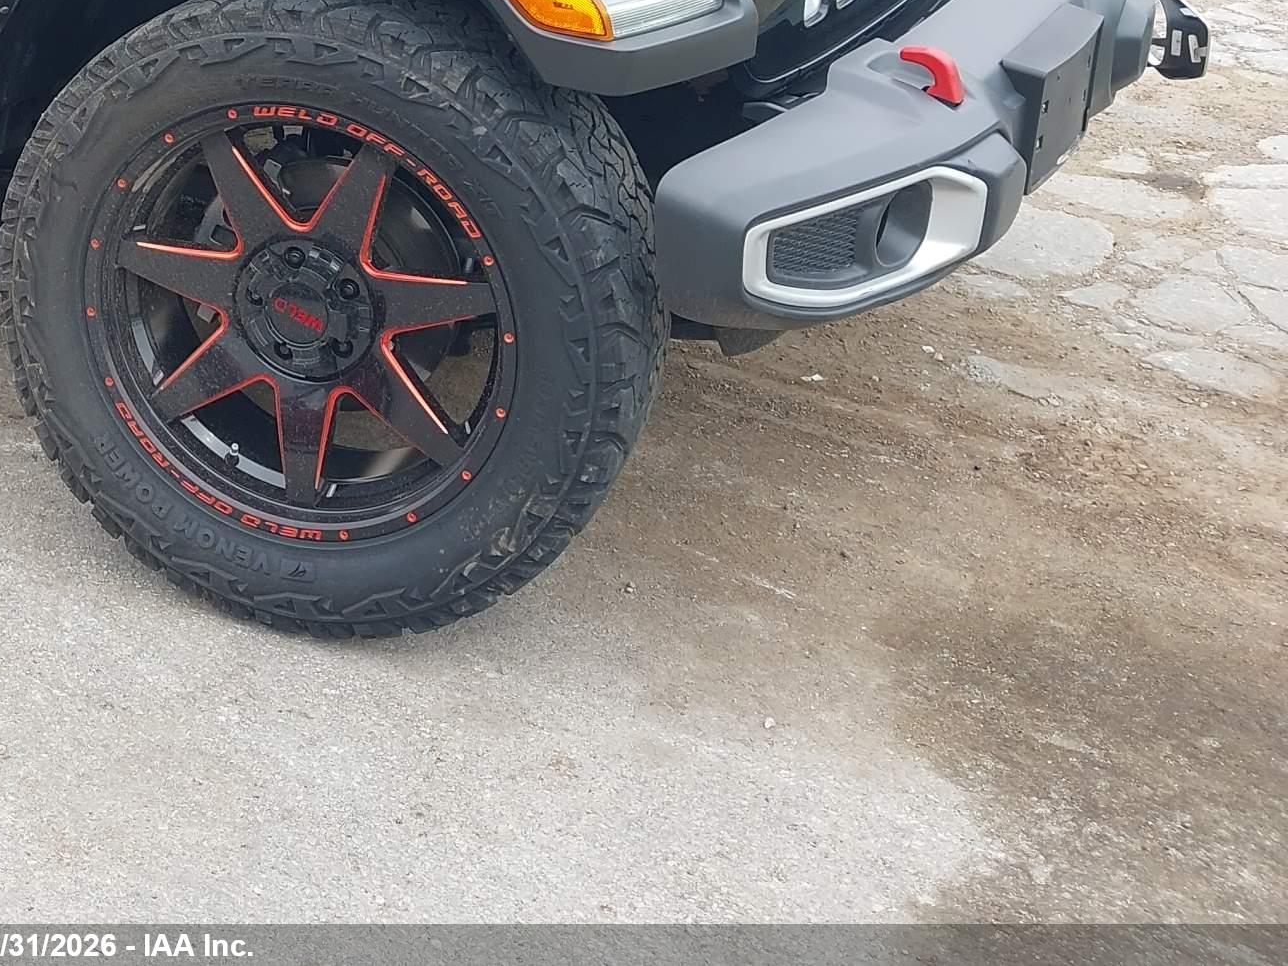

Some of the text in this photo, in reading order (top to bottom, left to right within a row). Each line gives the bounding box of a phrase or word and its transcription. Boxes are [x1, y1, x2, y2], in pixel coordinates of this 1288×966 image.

[253, 105, 482, 240] WELD OFF-ROAD
[274, 297, 324, 332] WELD
[89, 432, 272, 576] VENOM POWER
[114, 401, 323, 541] WELD OFF-ROAD
